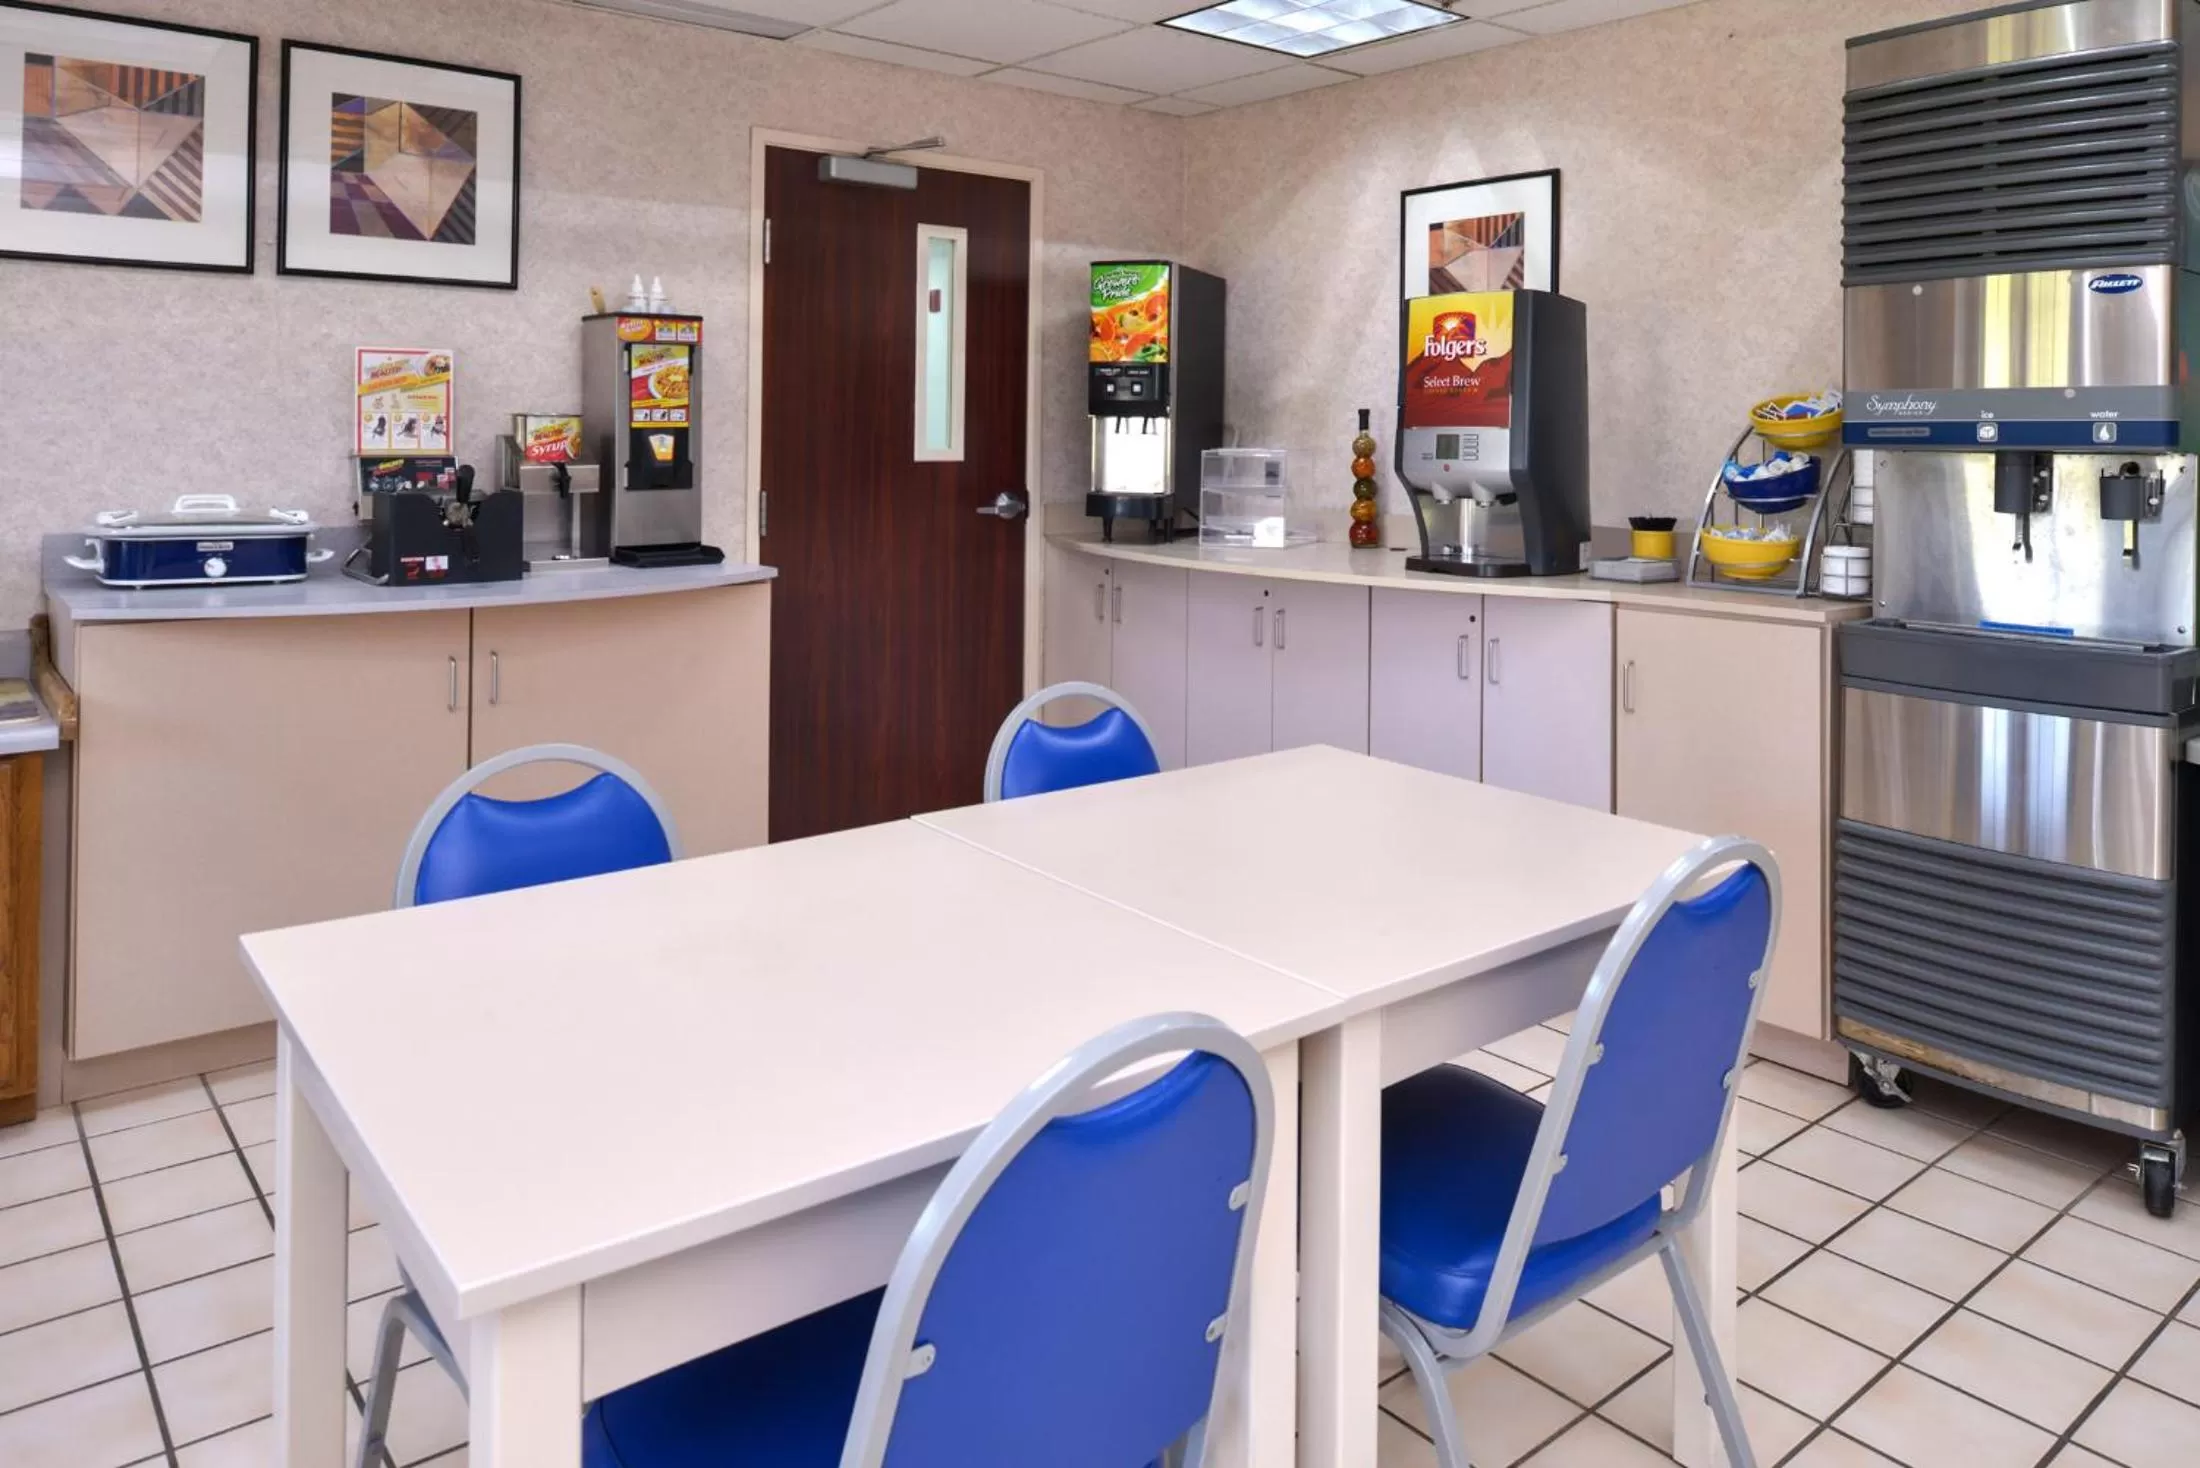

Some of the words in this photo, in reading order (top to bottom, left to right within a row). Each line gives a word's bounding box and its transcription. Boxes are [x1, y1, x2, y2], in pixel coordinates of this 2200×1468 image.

[1424, 334, 1487, 361] Folgers
[1423, 376, 1450, 388] Select
[1452, 375, 1481, 387] Brew
[1866, 394, 1937, 416] Symphony
[1980, 410, 1995, 419] ice
[2090, 410, 2119, 419] water
